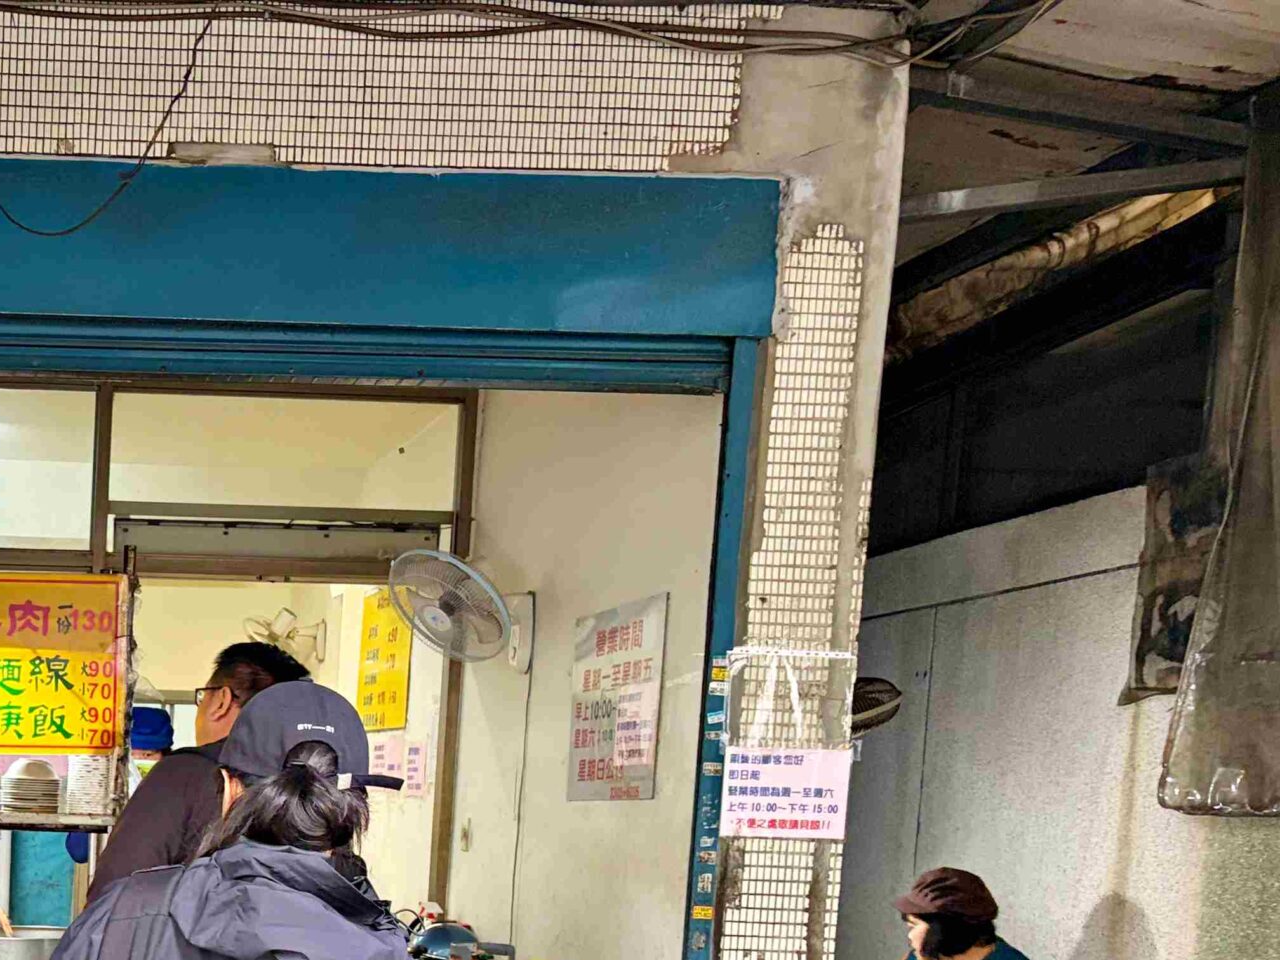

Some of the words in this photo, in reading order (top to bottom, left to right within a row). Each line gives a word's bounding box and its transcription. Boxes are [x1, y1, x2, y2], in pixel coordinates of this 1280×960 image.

[72, 609, 113, 632] 130
[595, 619, 644, 657] 營業時間
[729, 769, 760, 781] 即日起
[727, 802, 748, 812] 上午
[813, 804, 838, 814] 15:00
